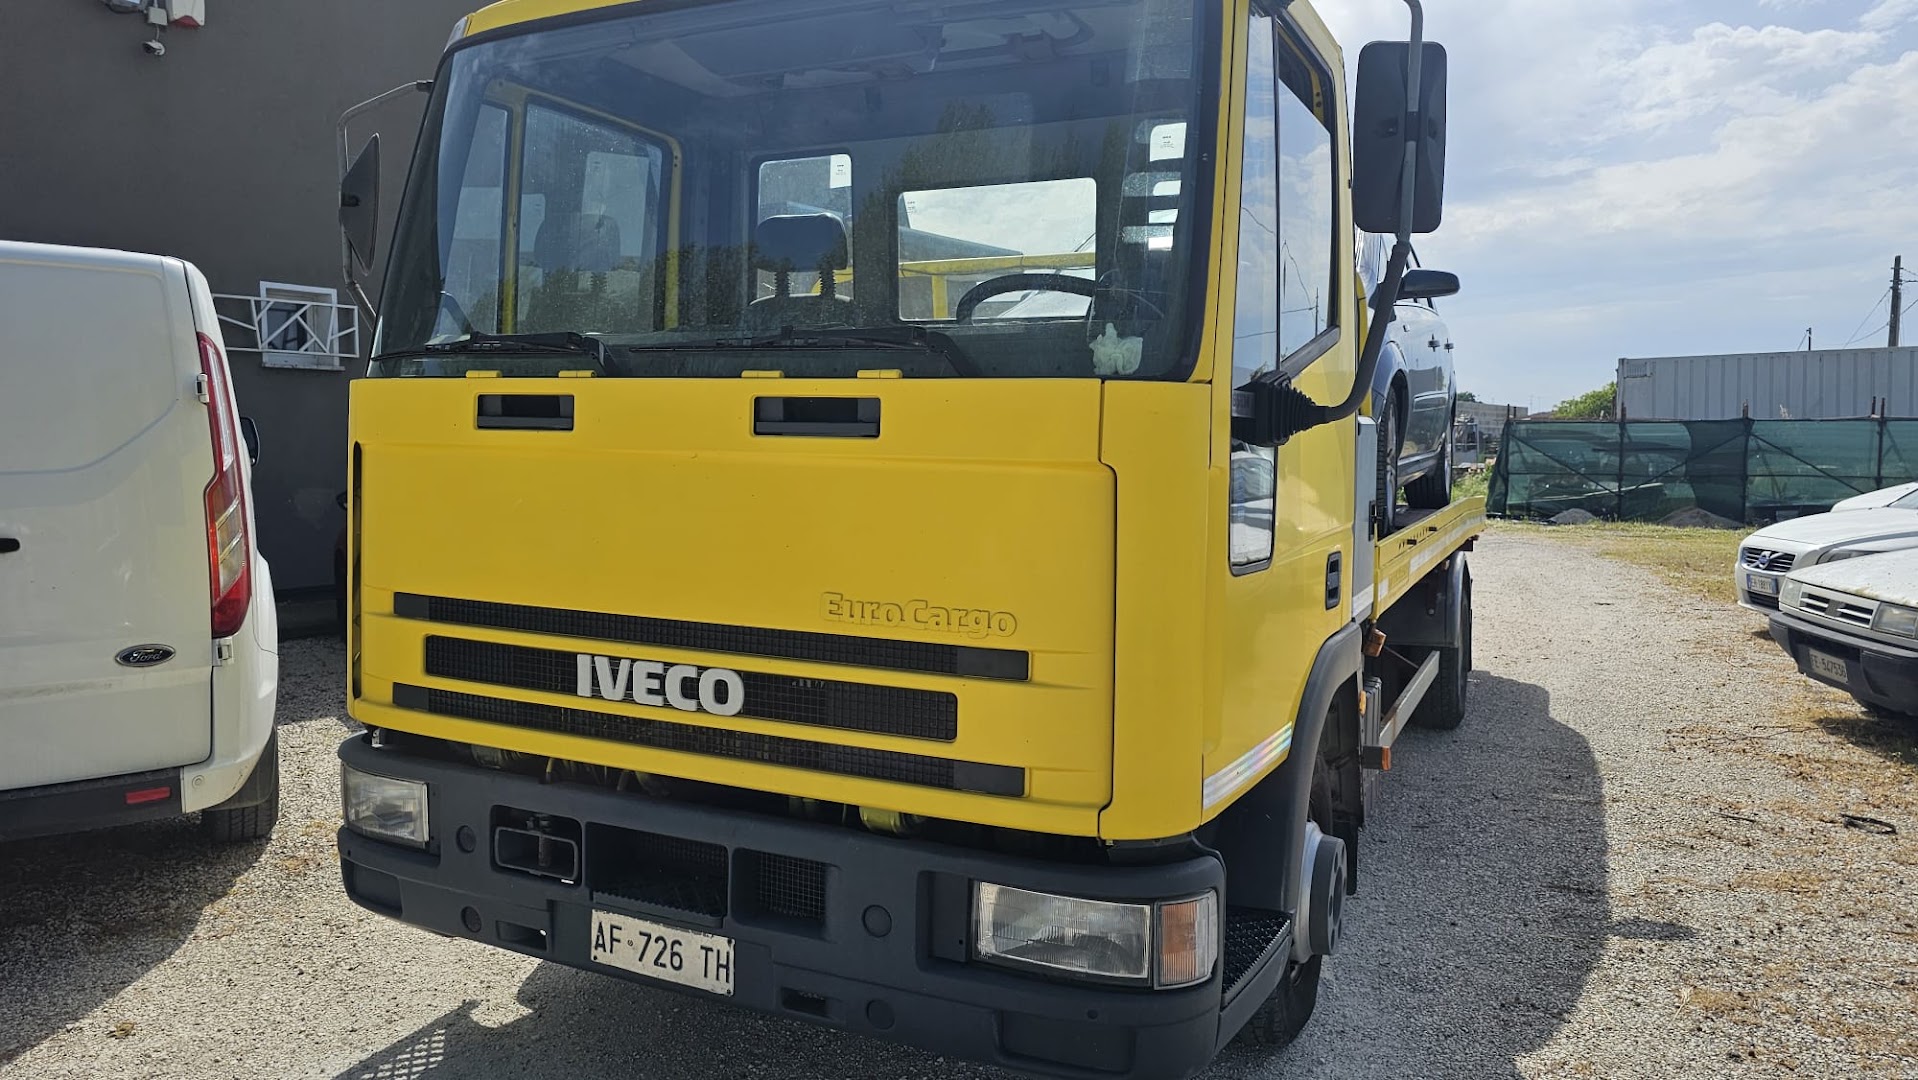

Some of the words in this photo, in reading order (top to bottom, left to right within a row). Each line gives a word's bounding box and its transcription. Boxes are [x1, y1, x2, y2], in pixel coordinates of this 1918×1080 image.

[821, 592, 1017, 639] EuroCargo
[130, 649, 163, 662] Ford
[577, 653, 744, 716] IVECO
[594, 921, 622, 954] AF
[638, 930, 683, 972] 726
[700, 944, 730, 983] TH
